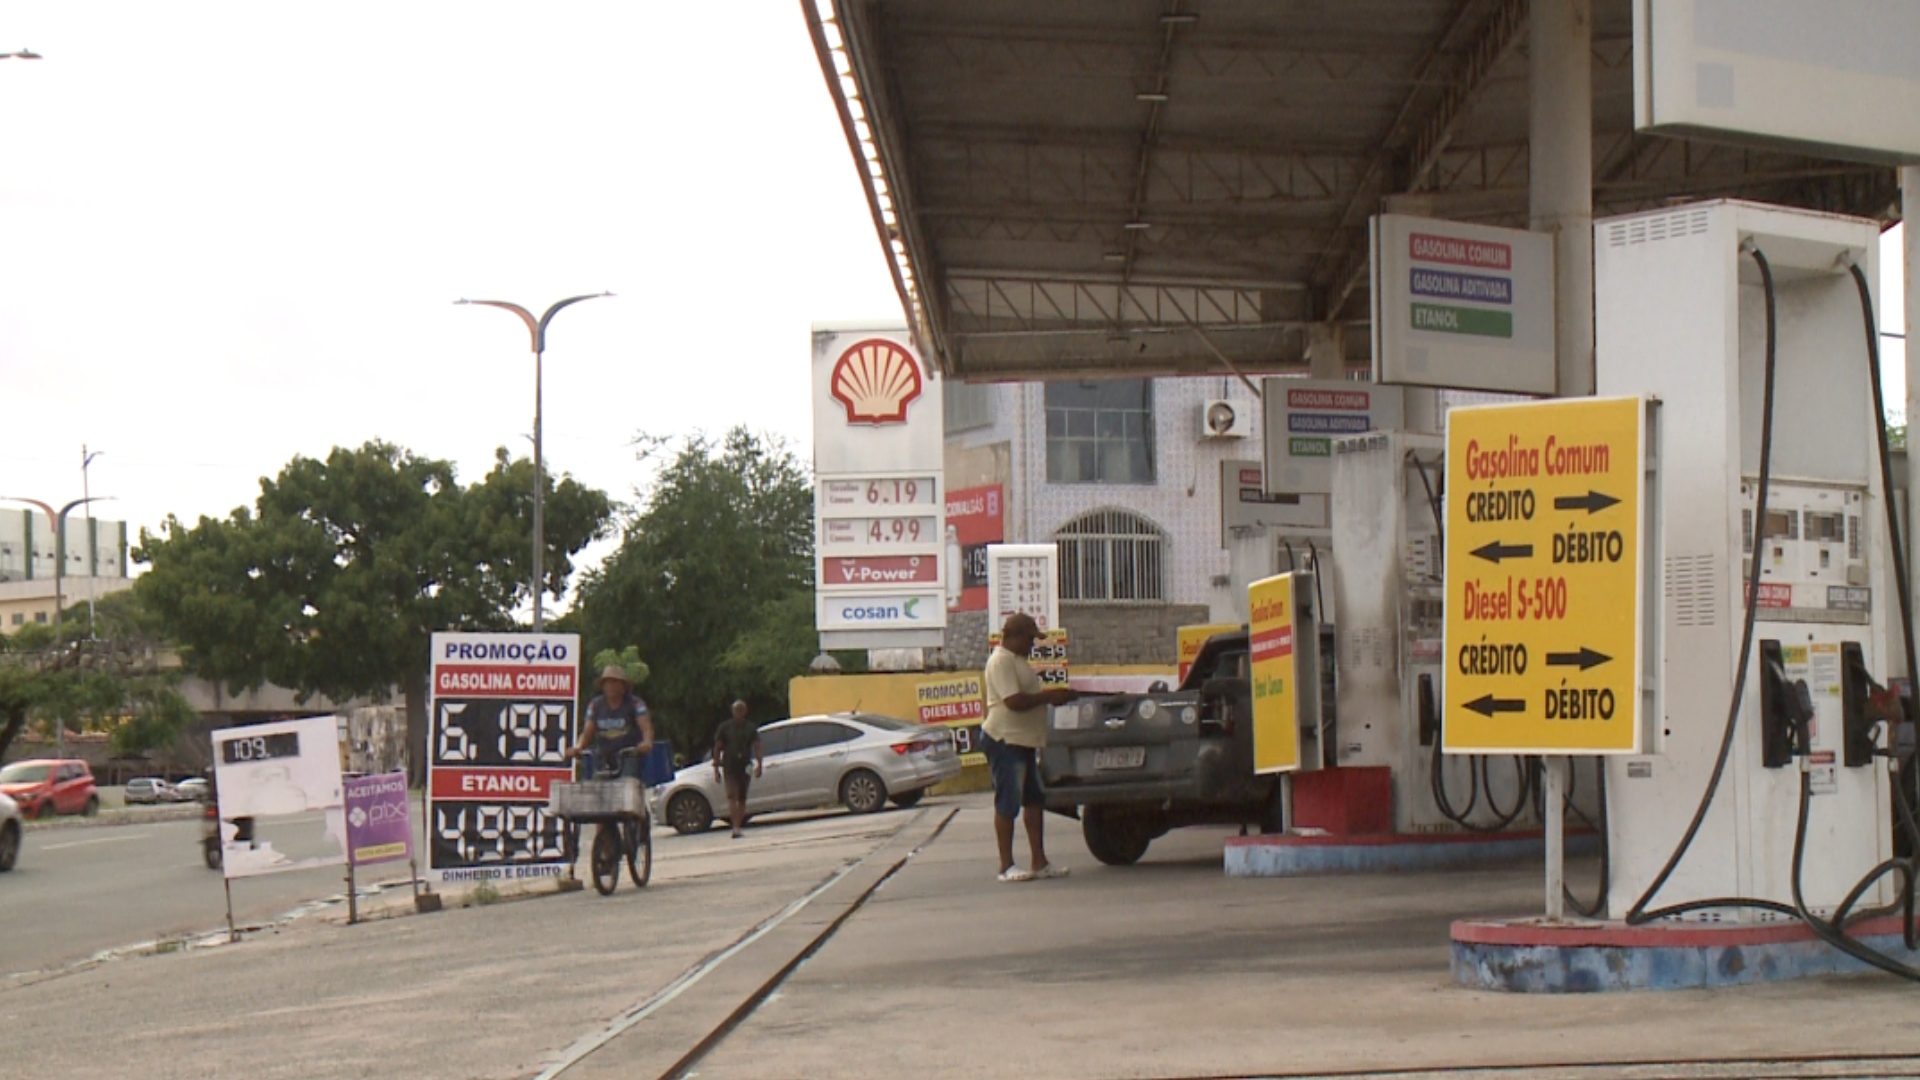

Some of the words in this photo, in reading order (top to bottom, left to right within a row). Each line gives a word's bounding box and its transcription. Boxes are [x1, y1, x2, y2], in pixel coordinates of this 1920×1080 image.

[1414, 238, 1466, 260] GASOLINA
[1468, 244, 1507, 265] COMUM
[1414, 273, 1460, 294] GASOLINA
[1461, 278, 1508, 300] ADITIVADA
[1415, 308, 1459, 328] ETANOL
[1290, 392, 1334, 406] GASOLINA
[1337, 395, 1366, 408] COMUM
[1291, 441, 1328, 454] ETANOL
[1466, 434, 1539, 480] Gasolina
[1545, 434, 1609, 476] Comum
[867, 480, 917, 503] 6.19
[1466, 481, 1535, 522] CRÉDITO
[870, 518, 920, 542] 4.99
[1552, 521, 1623, 564] DÉBITO
[842, 566, 916, 580] V-Power
[1464, 575, 1512, 621] Diesel
[1517, 576, 1567, 620] S-500
[842, 605, 898, 619] cosan
[446, 640, 567, 663] PROMOÇÃO
[1459, 634, 1527, 675] CRÉDITO
[440, 673, 513, 690] GASOLINA
[517, 674, 571, 691] COMUM
[918, 681, 979, 700] PROMOÇÃO
[1545, 678, 1614, 720] DÉBITO
[922, 703, 958, 719] DIESEL
[348, 781, 404, 799] ACEITAMOS
[462, 776, 541, 791] ETANOL
[369, 801, 405, 827] pix
[443, 870, 501, 881] DINHEIRO
[505, 869, 513, 878] E
